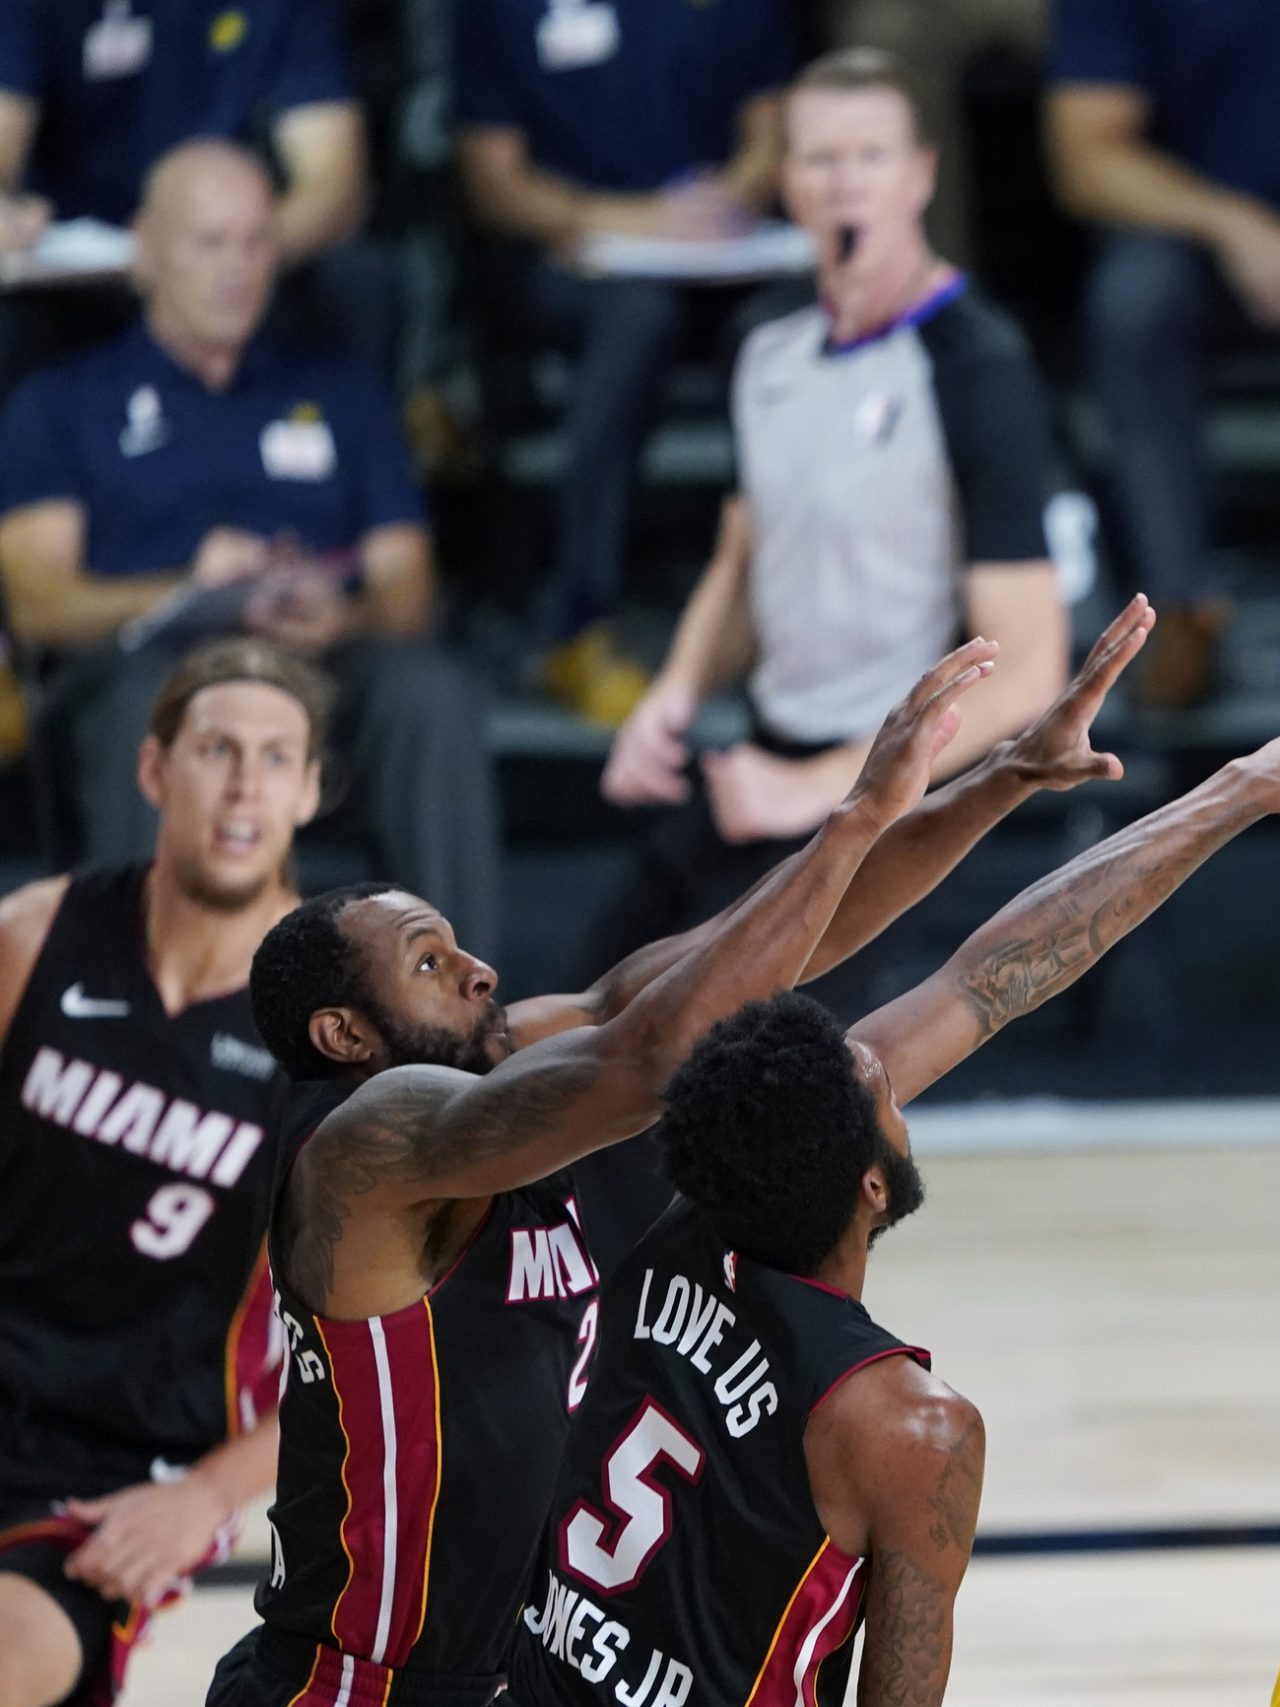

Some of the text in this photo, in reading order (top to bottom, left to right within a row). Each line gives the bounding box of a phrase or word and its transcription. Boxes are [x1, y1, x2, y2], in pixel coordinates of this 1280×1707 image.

[21, 1046, 265, 1189] MIAMI
[130, 1181, 214, 1261] 9
[634, 1268, 779, 1439] LOVE US
[559, 1392, 706, 1598] 5
[523, 1568, 631, 1684] JONES
